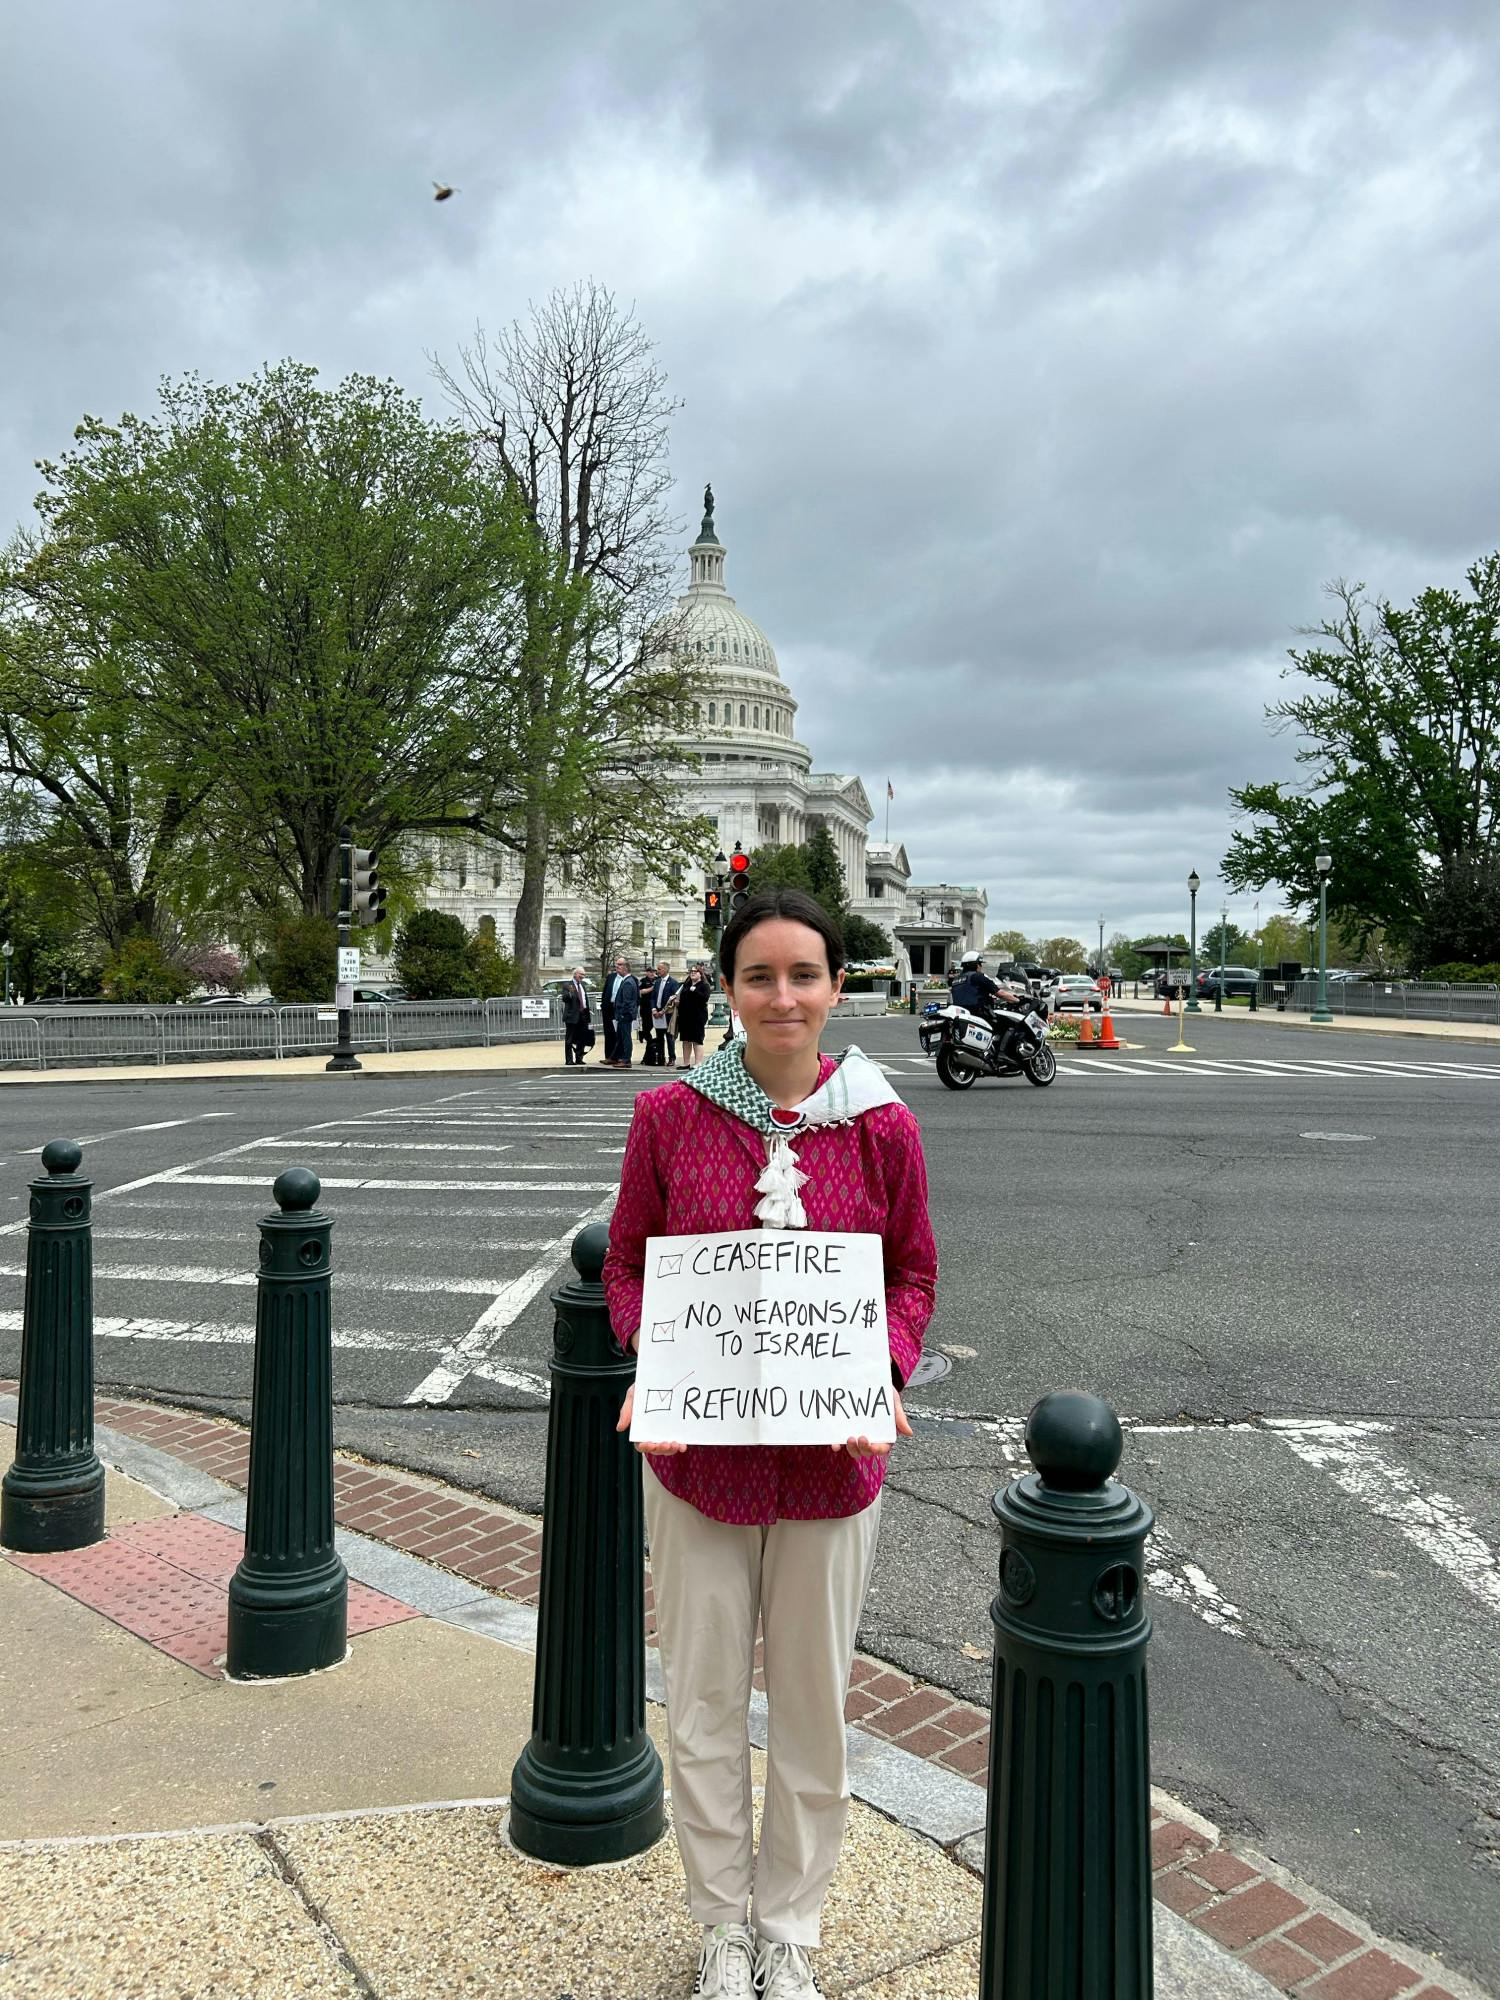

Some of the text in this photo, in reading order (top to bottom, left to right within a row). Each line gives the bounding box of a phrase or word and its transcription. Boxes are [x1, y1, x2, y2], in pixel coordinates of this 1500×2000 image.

[692, 1241, 847, 1275] CEASEFIRE
[685, 1298, 878, 1329] NO WEAPONS/$
[715, 1330, 851, 1359] TO ISRAEL
[682, 1386, 891, 1421] REFUND UNRWA
